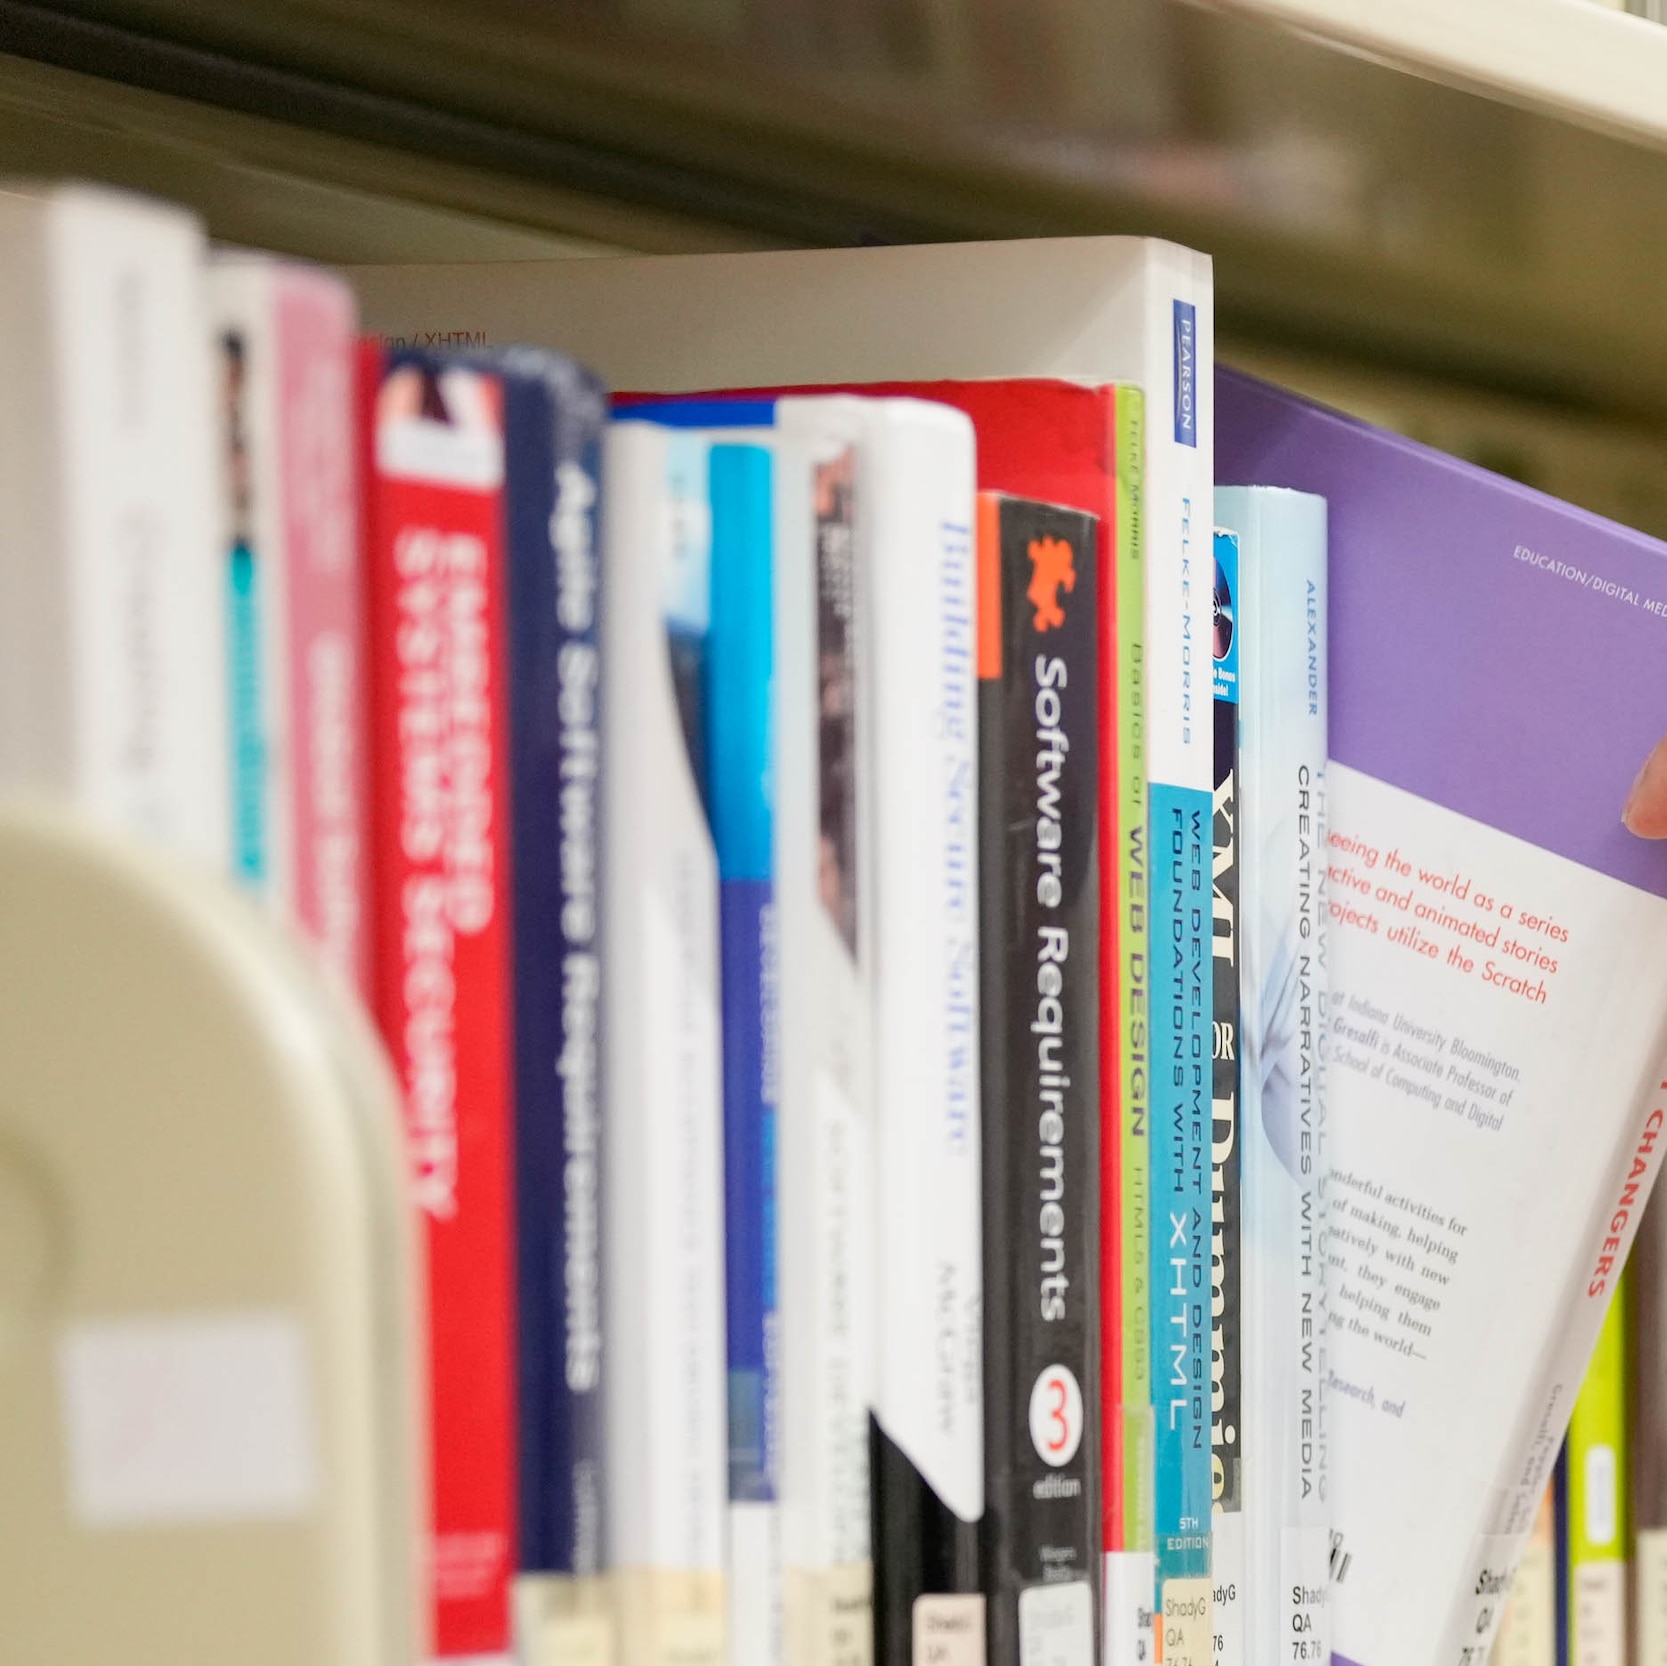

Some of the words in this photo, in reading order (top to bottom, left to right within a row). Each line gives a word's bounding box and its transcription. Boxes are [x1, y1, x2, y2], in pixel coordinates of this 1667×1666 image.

[1179, 317, 1194, 432] PEARSON
[1512, 544, 1641, 608] EDUCATION/DIGITAL
[1181, 497, 1193, 745] FELKE-MORRIS
[1305, 578, 1319, 716] ALEXANDER
[1129, 644, 1145, 760] Basics
[1033, 653, 1069, 908] Software
[1128, 826, 1144, 933] WEB
[1190, 809, 1201, 892] WEB
[1298, 764, 1311, 940] CREATING
[1375, 886, 1414, 911] and
[1413, 902, 1501, 948] animated
[1501, 937, 1559, 974] stories
[1384, 848, 1412, 877] the
[1418, 873, 1472, 901] world
[1473, 891, 1495, 912] as
[1499, 903, 1513, 919] a
[1517, 911, 1570, 943] series
[1171, 808, 1185, 1088] FOUNDATIONS
[1386, 924, 1440, 959] utilize
[1446, 944, 1475, 974] the
[1481, 960, 1548, 1005] Scratch
[1129, 952, 1146, 1137] DESIGN
[1191, 899, 1202, 1195] DEVELOPMENT
[1299, 955, 1313, 1176] NARRATIVES
[1347, 994, 1390, 1026] Indiana
[1392, 1012, 1447, 1052] University
[1332, 1044, 1371, 1075] School
[1385, 1068, 1443, 1110] Computing
[1443, 1095, 1468, 1117] and
[1466, 1102, 1505, 1133] Digital
[1391, 1042, 1444, 1079] Associate
[1445, 1064, 1497, 1101] Professor
[1498, 1089, 1514, 1108] of
[1030, 925, 1070, 1323] Requirements
[1173, 1103, 1185, 1194] WITH
[1192, 1206, 1202, 1289] AND
[1300, 1190, 1313, 1279] WITH
[1331, 1198, 1349, 1213] of
[1406, 1226, 1460, 1266] helping
[1383, 1191, 1446, 1229] activities
[1447, 1216, 1469, 1238] for
[1586, 1108, 1666, 1300] CHANGERS
[1338, 1284, 1391, 1322] helping
[1396, 1311, 1433, 1338] them
[1357, 1263, 1388, 1290] they
[1394, 1283, 1442, 1313] engage
[1384, 1248, 1416, 1273] with
[1419, 1265, 1451, 1287] new
[1168, 1211, 1188, 1432] XHTML
[1300, 1291, 1313, 1372] NEW
[1346, 1316, 1371, 1338] the
[1045, 1377, 1070, 1452] 3
[1192, 1303, 1203, 1451] DESIGN
[1301, 1389, 1313, 1501] MEDIA
[1166, 1536, 1210, 1551] EDITION
[1178, 1516, 1199, 1531] 5TH
[1165, 1596, 1207, 1622] ShadyG
[1165, 1628, 1185, 1647] QA
[1292, 1613, 1312, 1633] QA
[1292, 1640, 1322, 1661] 76.76
